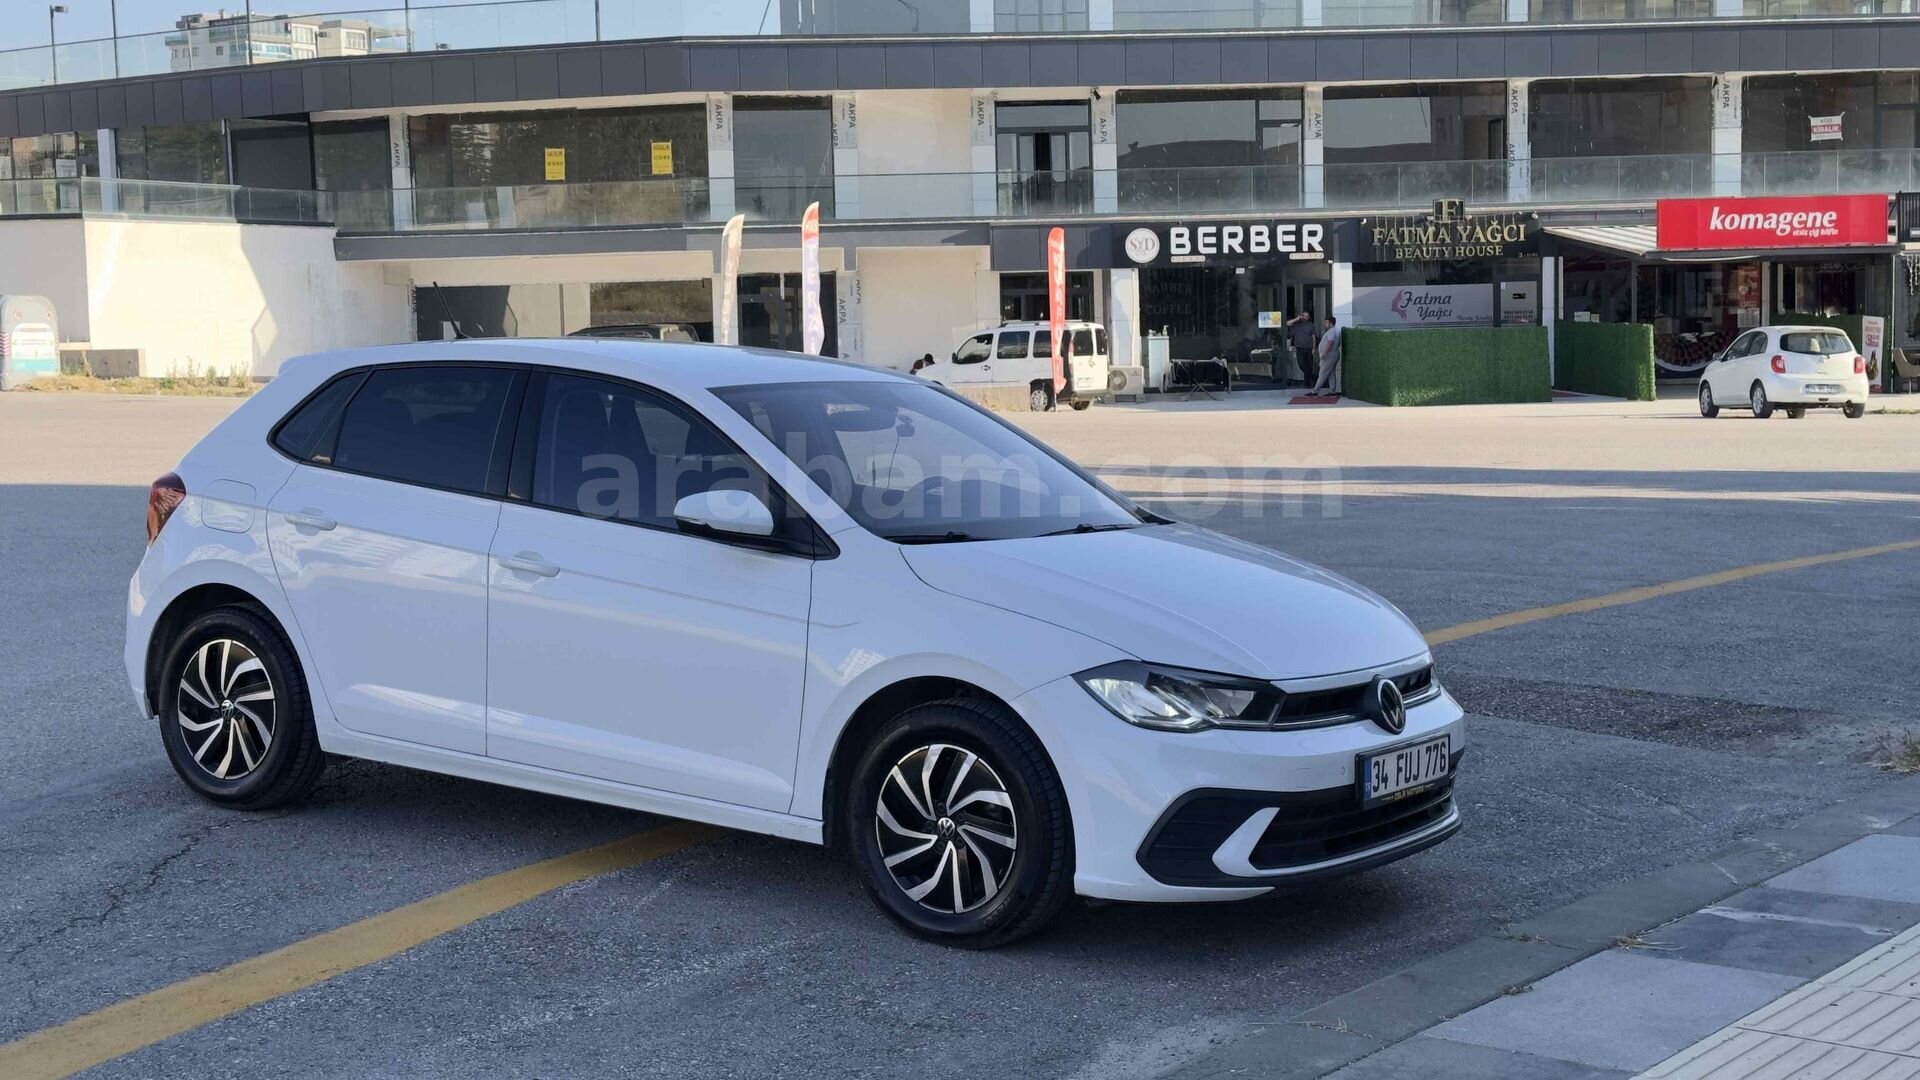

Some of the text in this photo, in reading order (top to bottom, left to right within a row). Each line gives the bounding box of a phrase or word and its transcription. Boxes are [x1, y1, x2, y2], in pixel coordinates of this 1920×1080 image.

[977, 100, 985, 126] AKPA
[1511, 88, 1519, 114] AKPA
[715, 104, 724, 130] AKPA
[848, 102, 857, 128] AKPA
[1372, 220, 1527, 246] FATMA YAĞCI
[1709, 206, 1837, 236] komagene
[1170, 224, 1324, 255] BERBER
[1395, 245, 1504, 259] BEAUTY HOUSE
[1400, 290, 1453, 309] Fatma
[1373, 741, 1447, 793] 34 FUJ 776
